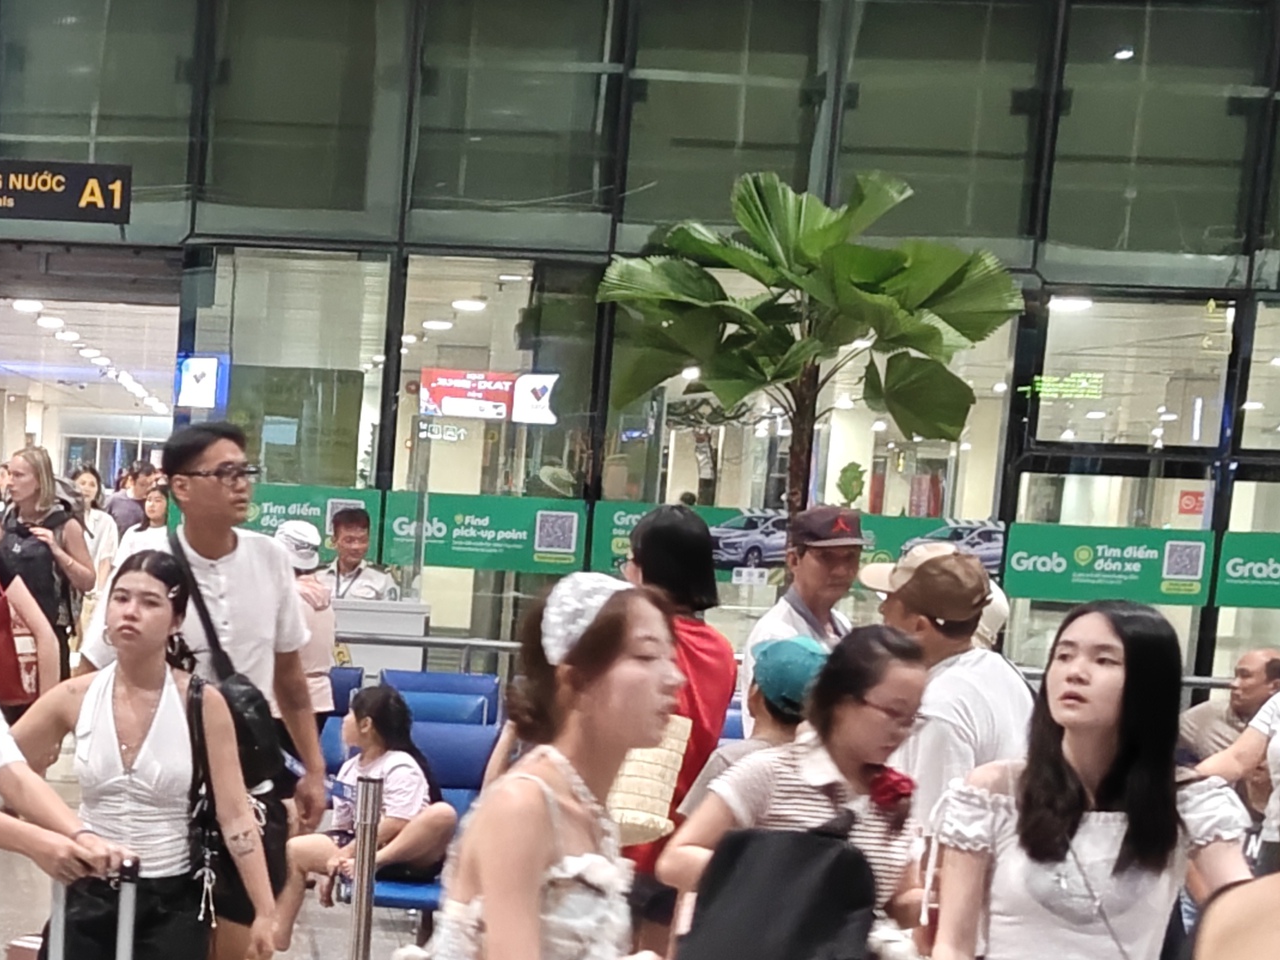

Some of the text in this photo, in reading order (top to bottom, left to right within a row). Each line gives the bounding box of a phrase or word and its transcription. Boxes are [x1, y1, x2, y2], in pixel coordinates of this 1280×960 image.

[9, 170, 66, 193] NƯỚC
[78, 178, 123, 209] A1
[261, 501, 320, 516] Tìm điểm
[464, 514, 490, 526] Find
[452, 526, 496, 540] pick-up
[497, 529, 528, 541] point
[1096, 544, 1158, 560] Tìm điểm
[1011, 551, 1067, 573] Grab
[1094, 558, 1141, 573] đón xe
[1226, 557, 1280, 579] Grab
